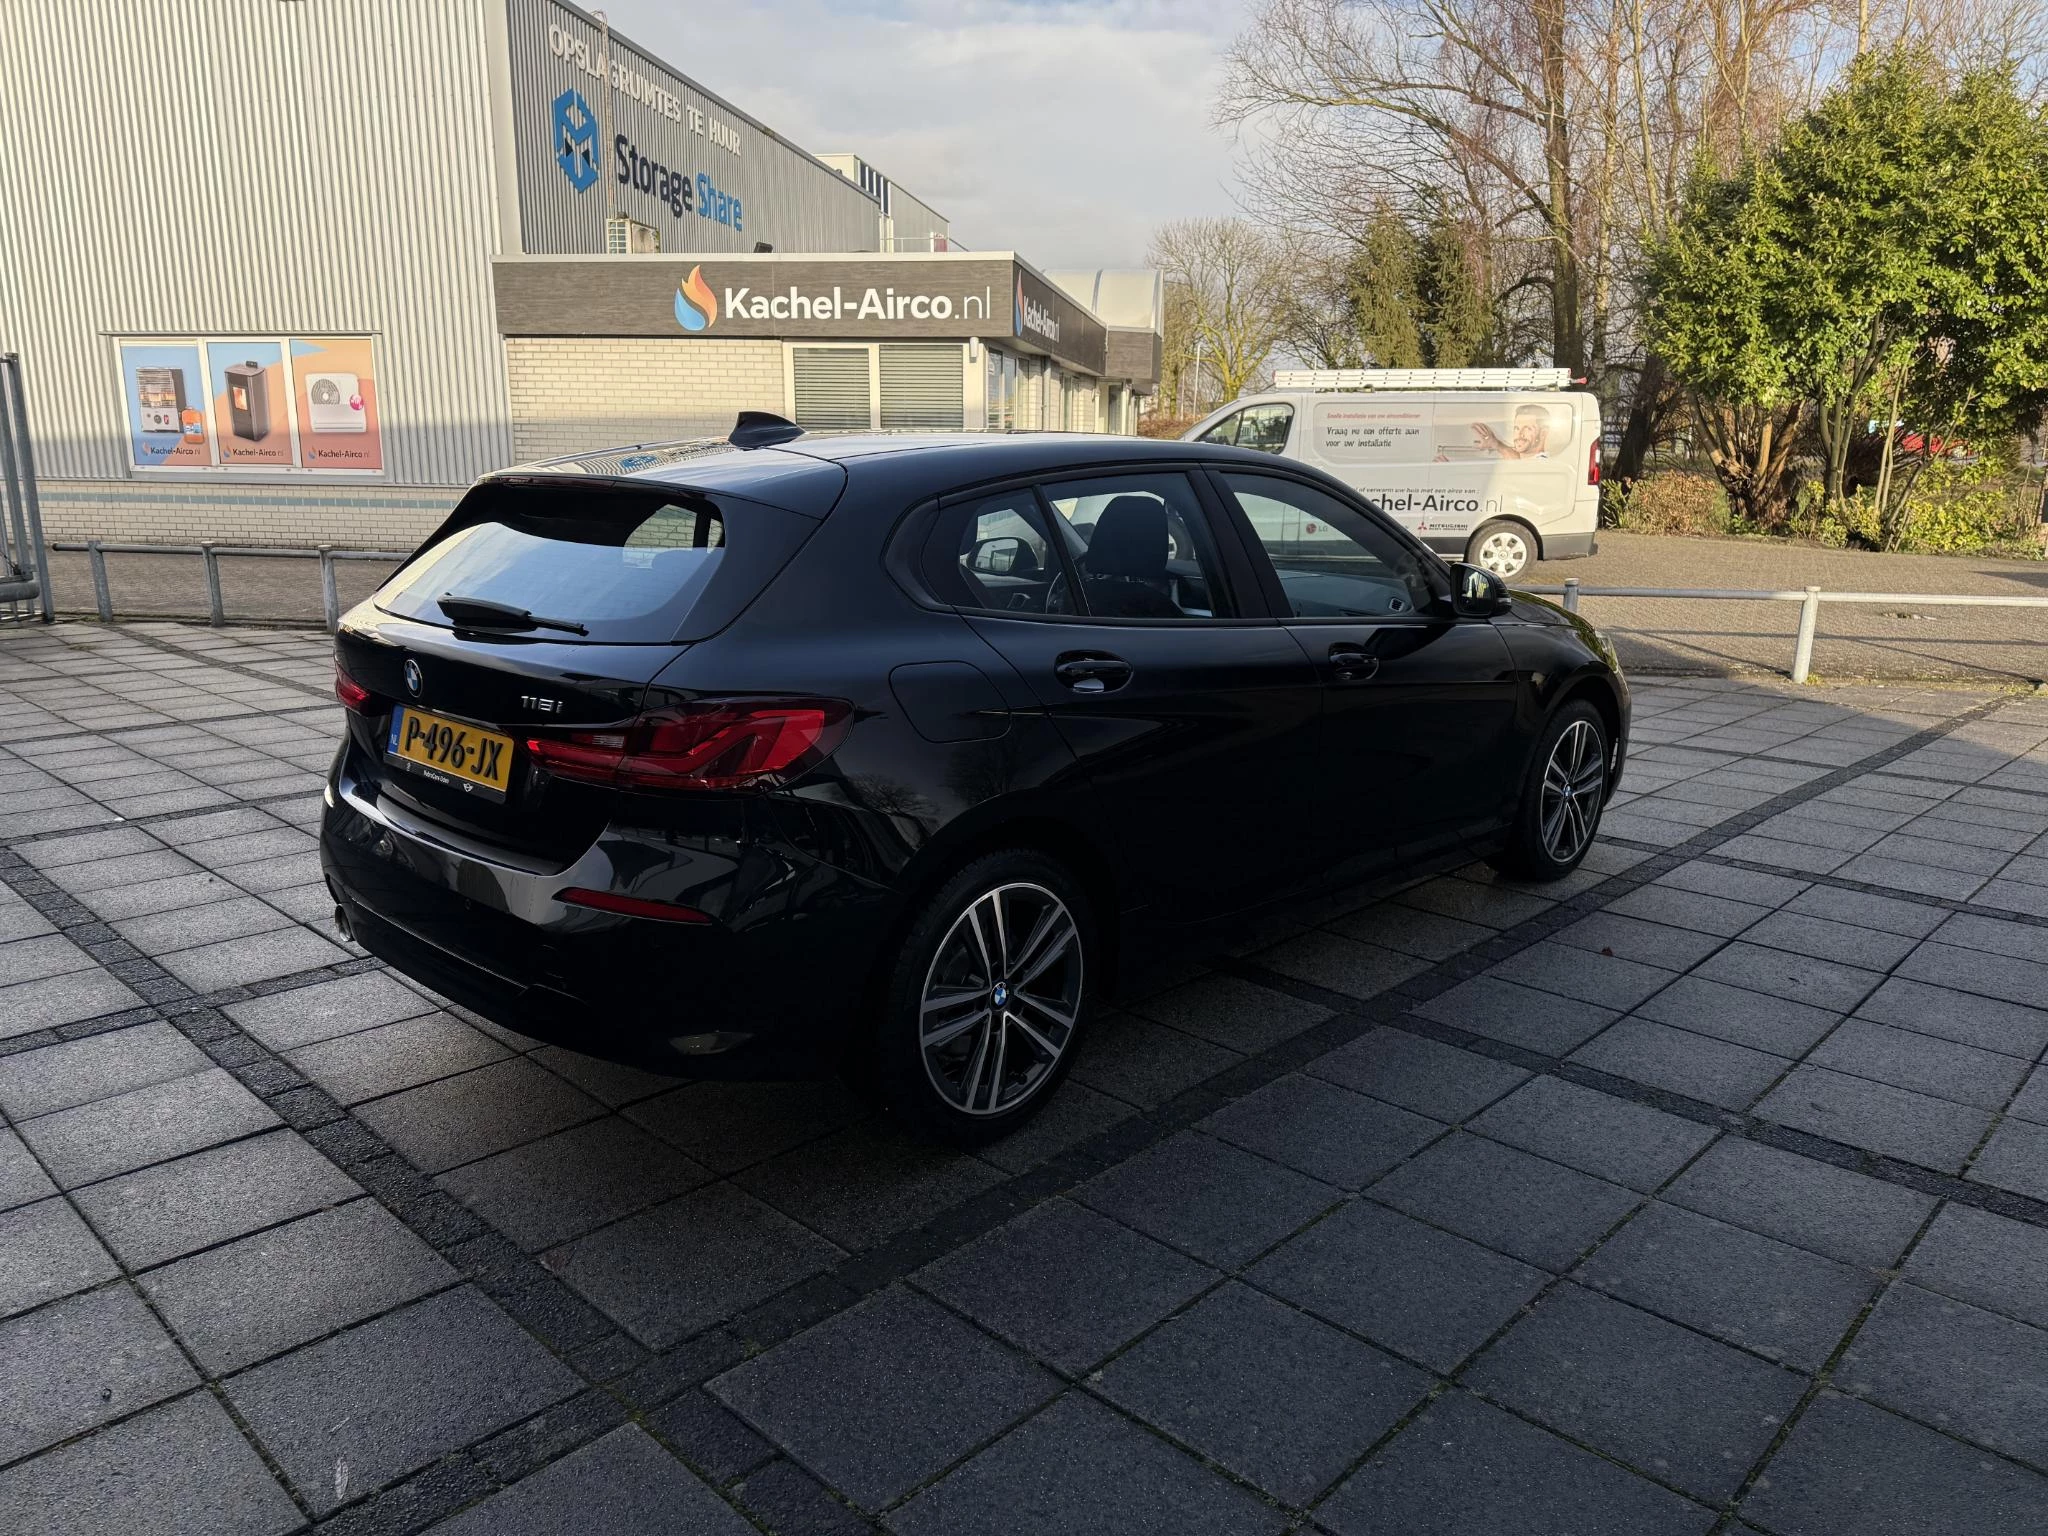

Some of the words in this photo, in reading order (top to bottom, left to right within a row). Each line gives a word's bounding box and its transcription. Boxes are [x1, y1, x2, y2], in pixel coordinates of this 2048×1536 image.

[550, 24, 681, 123] OPSLAGRUIMTES
[687, 104, 704, 136] TE
[709, 117, 741, 156] HUUR
[616, 134, 693, 219] Storage
[696, 172, 743, 232] Share
[725, 286, 991, 320] Kachel-Airco.nl
[1327, 427, 1348, 437] Vraag
[1378, 426, 1402, 435] offerte
[1357, 438, 1392, 448] installatie
[1371, 493, 1503, 513] hel-Airco.nl
[521, 695, 563, 714] 118i
[390, 733, 398, 746] NL
[405, 716, 504, 781] P-496-JX
